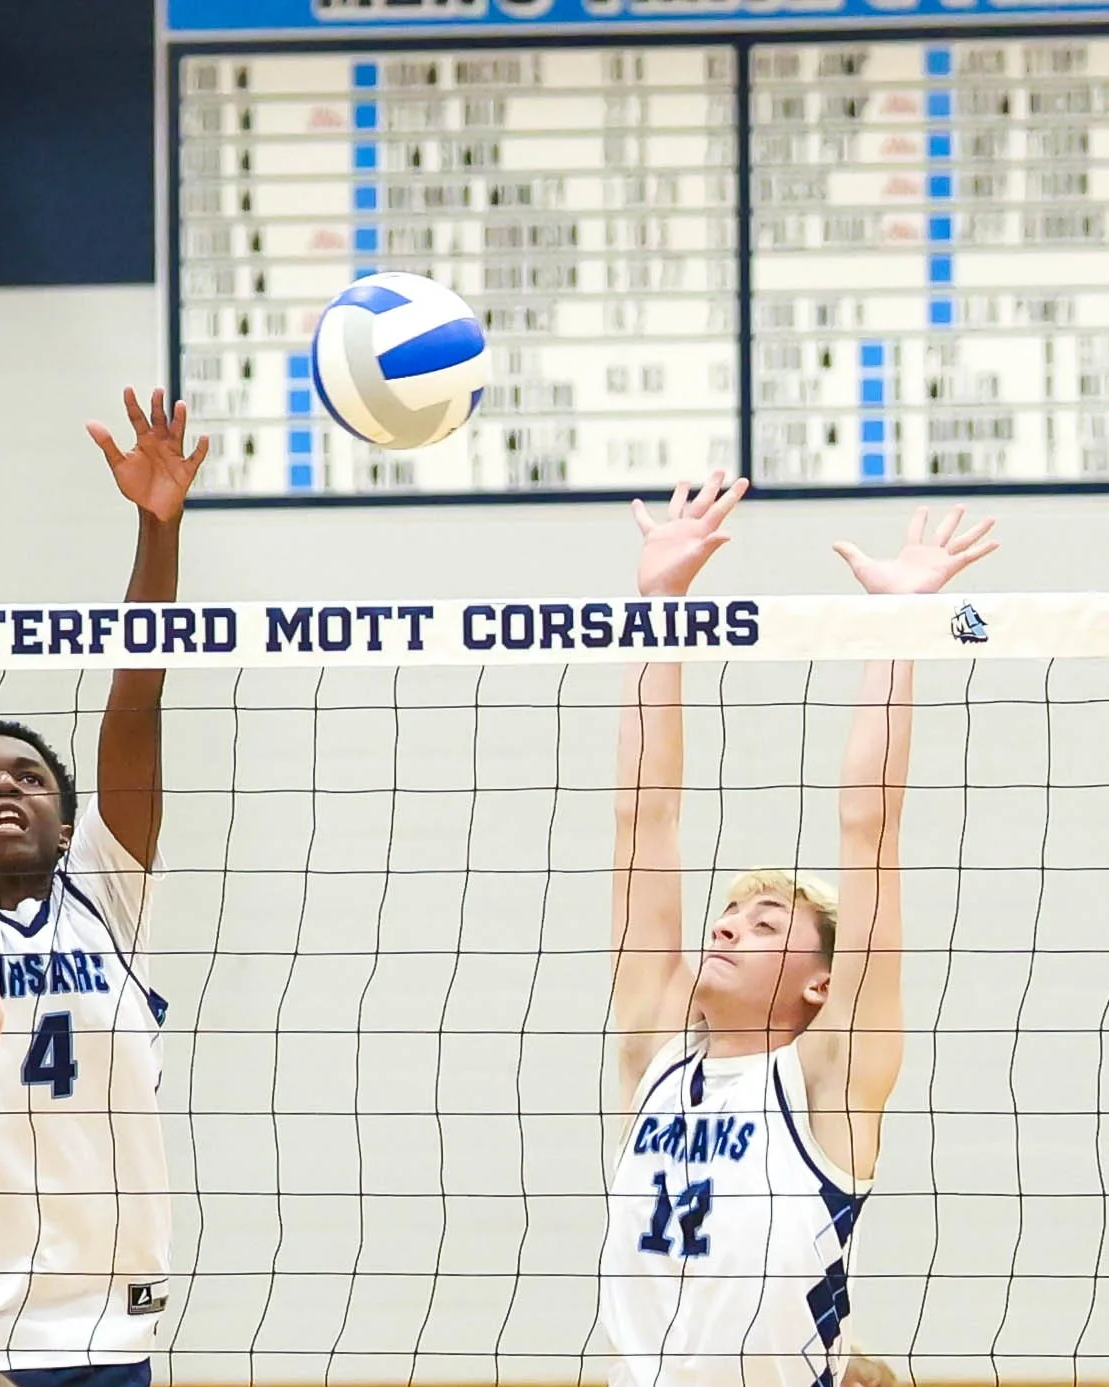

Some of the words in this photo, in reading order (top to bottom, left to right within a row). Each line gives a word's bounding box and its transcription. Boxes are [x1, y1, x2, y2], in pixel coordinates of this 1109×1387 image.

[266, 604, 434, 654] MOTT
[461, 600, 761, 652] CORSAIRS
[20, 1010, 78, 1099] 4
